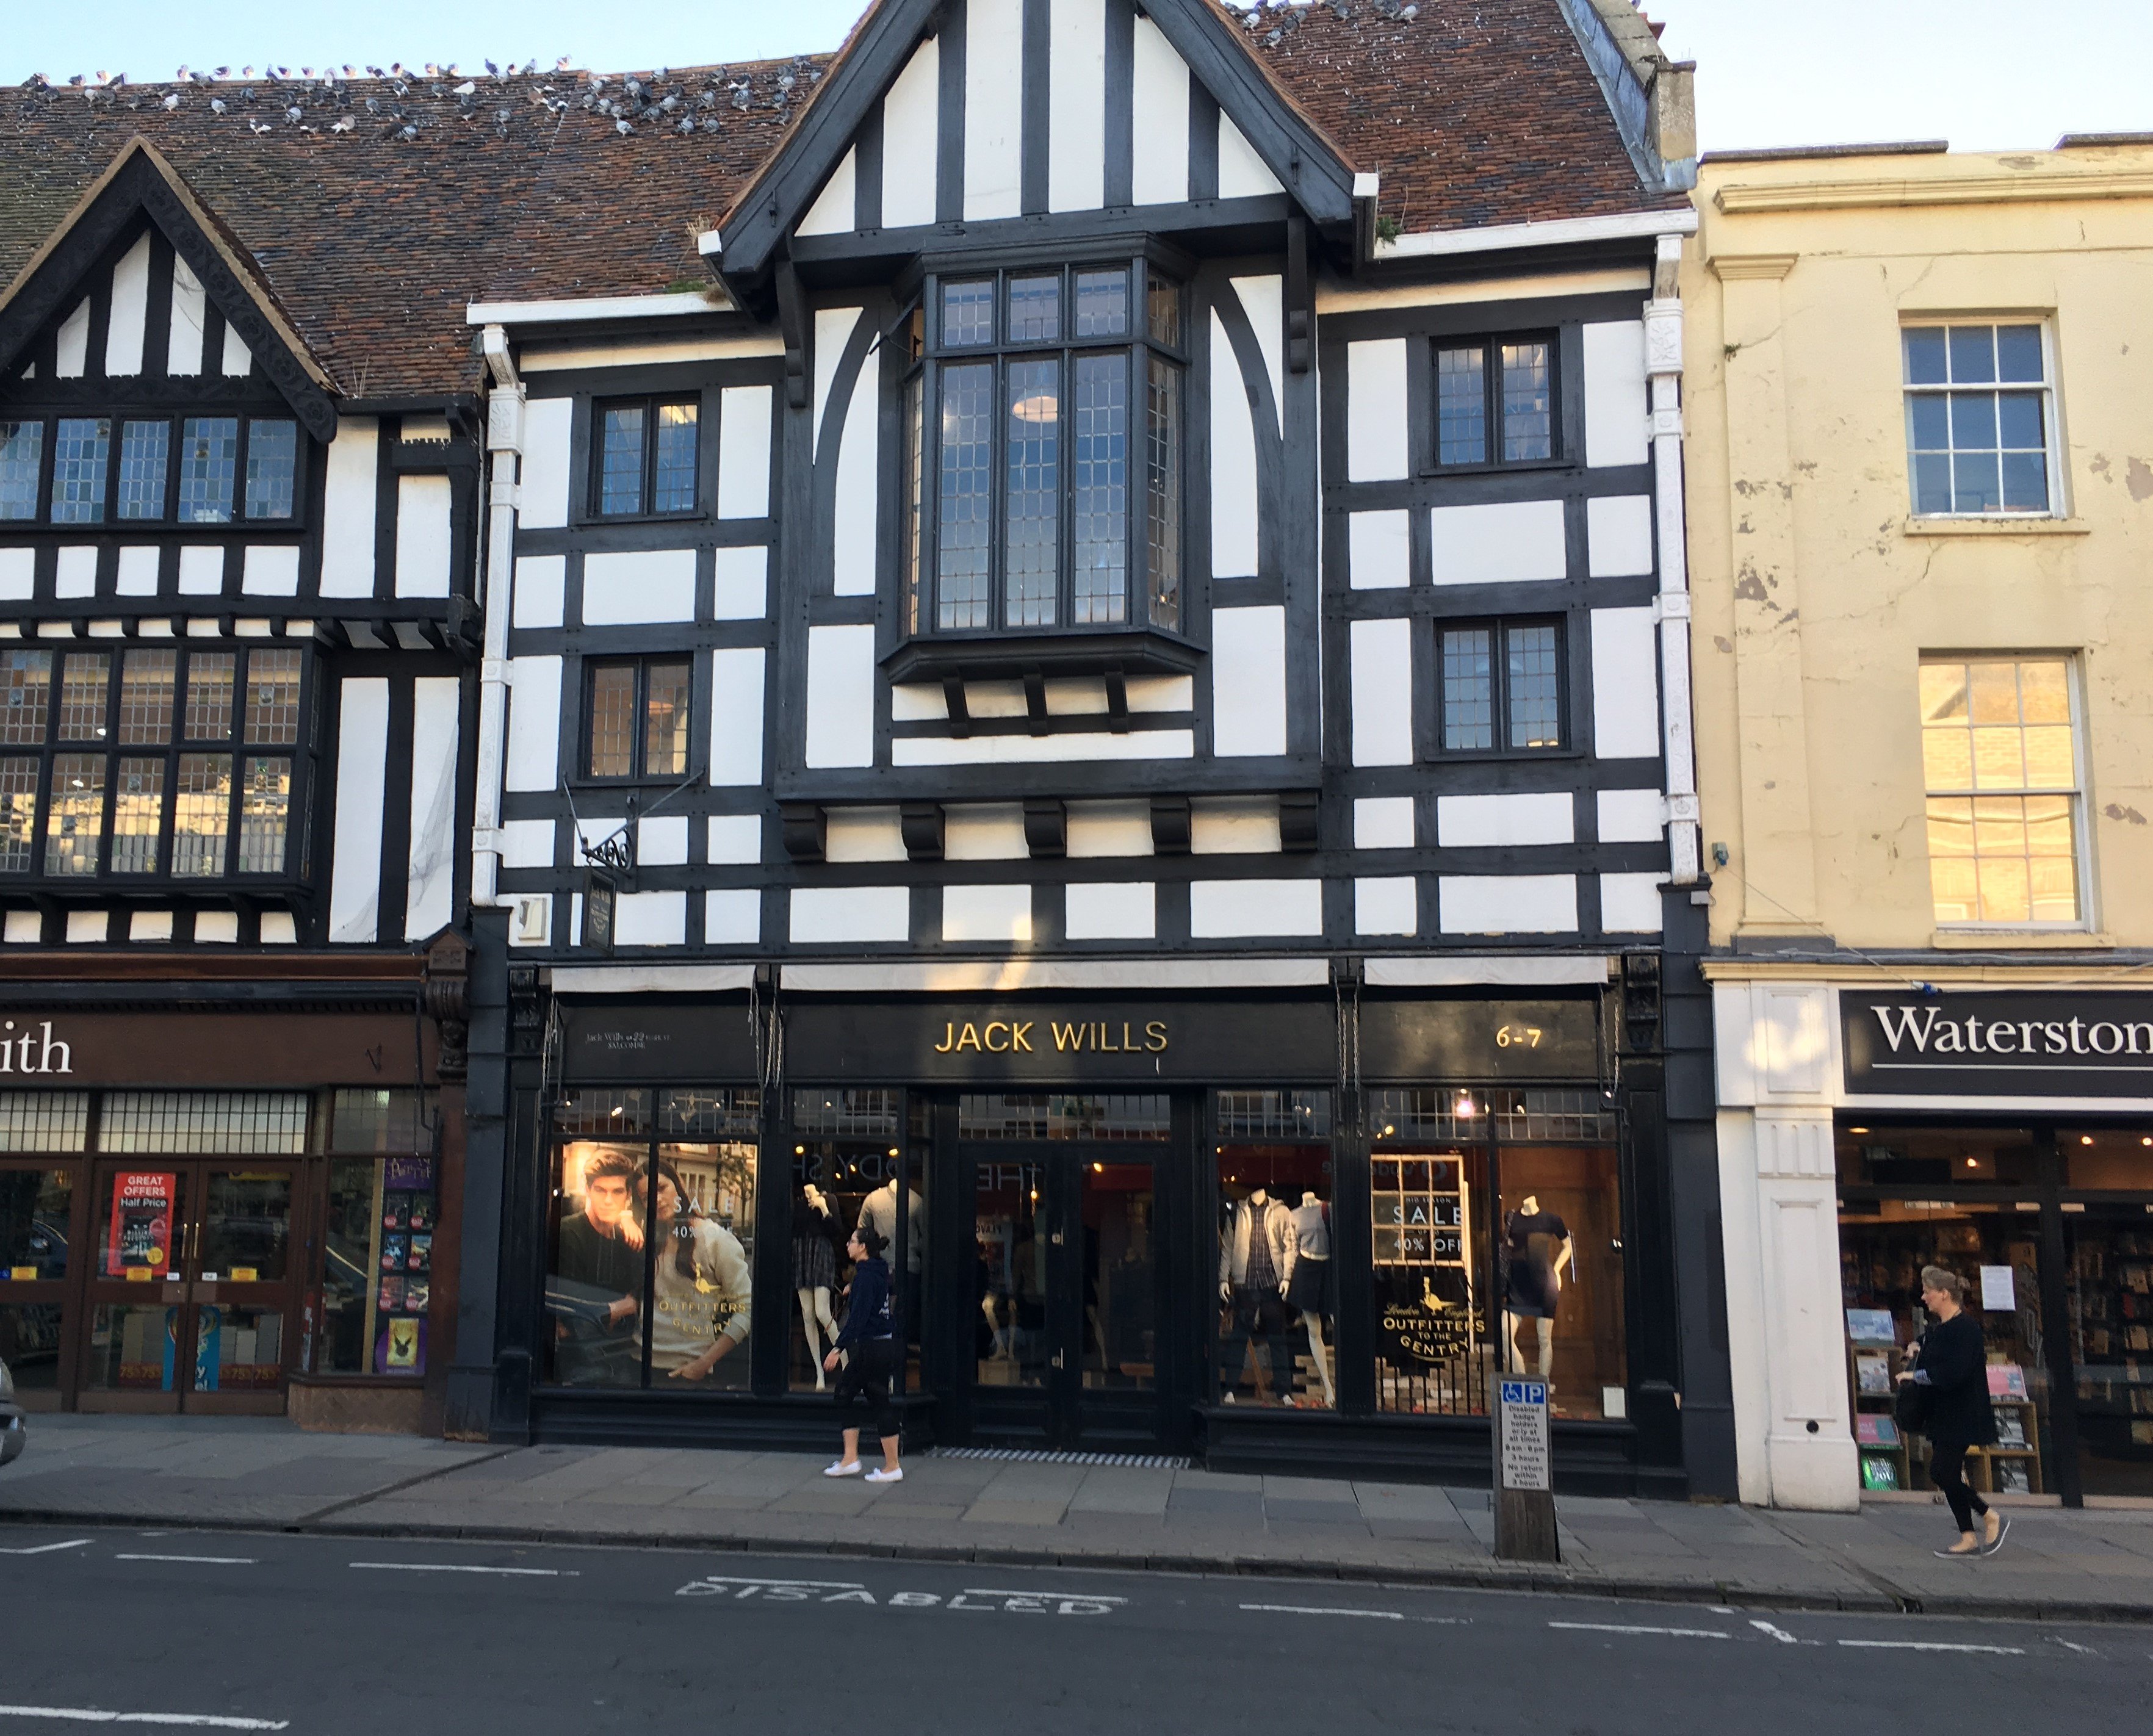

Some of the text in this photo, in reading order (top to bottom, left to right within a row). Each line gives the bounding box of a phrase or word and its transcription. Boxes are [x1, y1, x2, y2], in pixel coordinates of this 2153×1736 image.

[934, 1021, 1167, 1053] JACK WILLS
[1496, 1026, 1542, 1048] 6-7
[1870, 1006, 2153, 1054] Waterston
[0, 1020, 73, 1073] ith
[128, 1176, 164, 1185] GREAT
[124, 1186, 165, 1196] OFFERS
[121, 1198, 167, 1207] Half Price
[673, 1196, 733, 1214] SALE
[1393, 1205, 1462, 1225] SALE
[659, 1300, 746, 1313] OUTFITTERS
[673, 1317, 730, 1335] GENTRY
[1383, 1317, 1485, 1333] OUTFITTERS
[1418, 1331, 1451, 1341] TO THE
[1400, 1335, 1470, 1356] GENTRY
[1530, 1386, 1542, 1403] P
[1509, 1405, 1540, 1413] Disabled
[675, 1581, 1114, 1616] DISABLED
